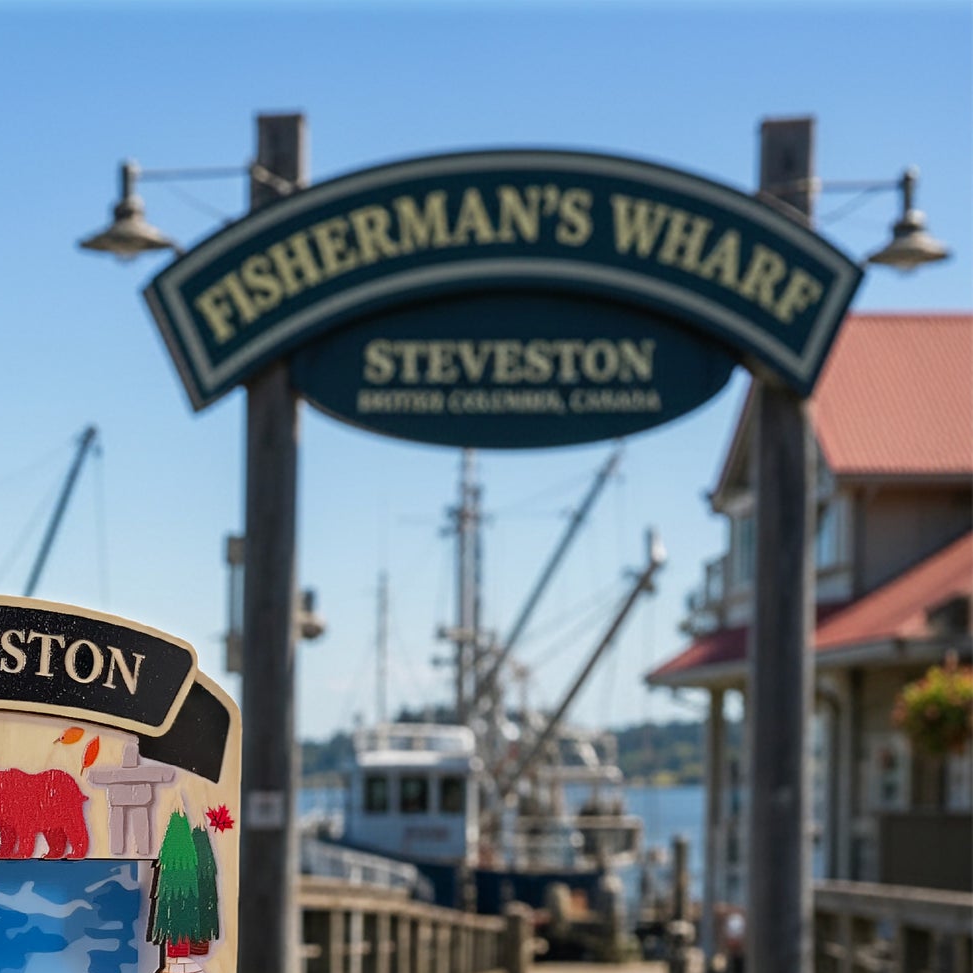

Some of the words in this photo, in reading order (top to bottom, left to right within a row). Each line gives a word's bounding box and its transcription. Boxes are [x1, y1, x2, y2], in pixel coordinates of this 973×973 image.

[196, 184, 594, 344] FISHERMAN'S
[610, 193, 824, 325] WHARF
[363, 338, 656, 385] STEVESTON
